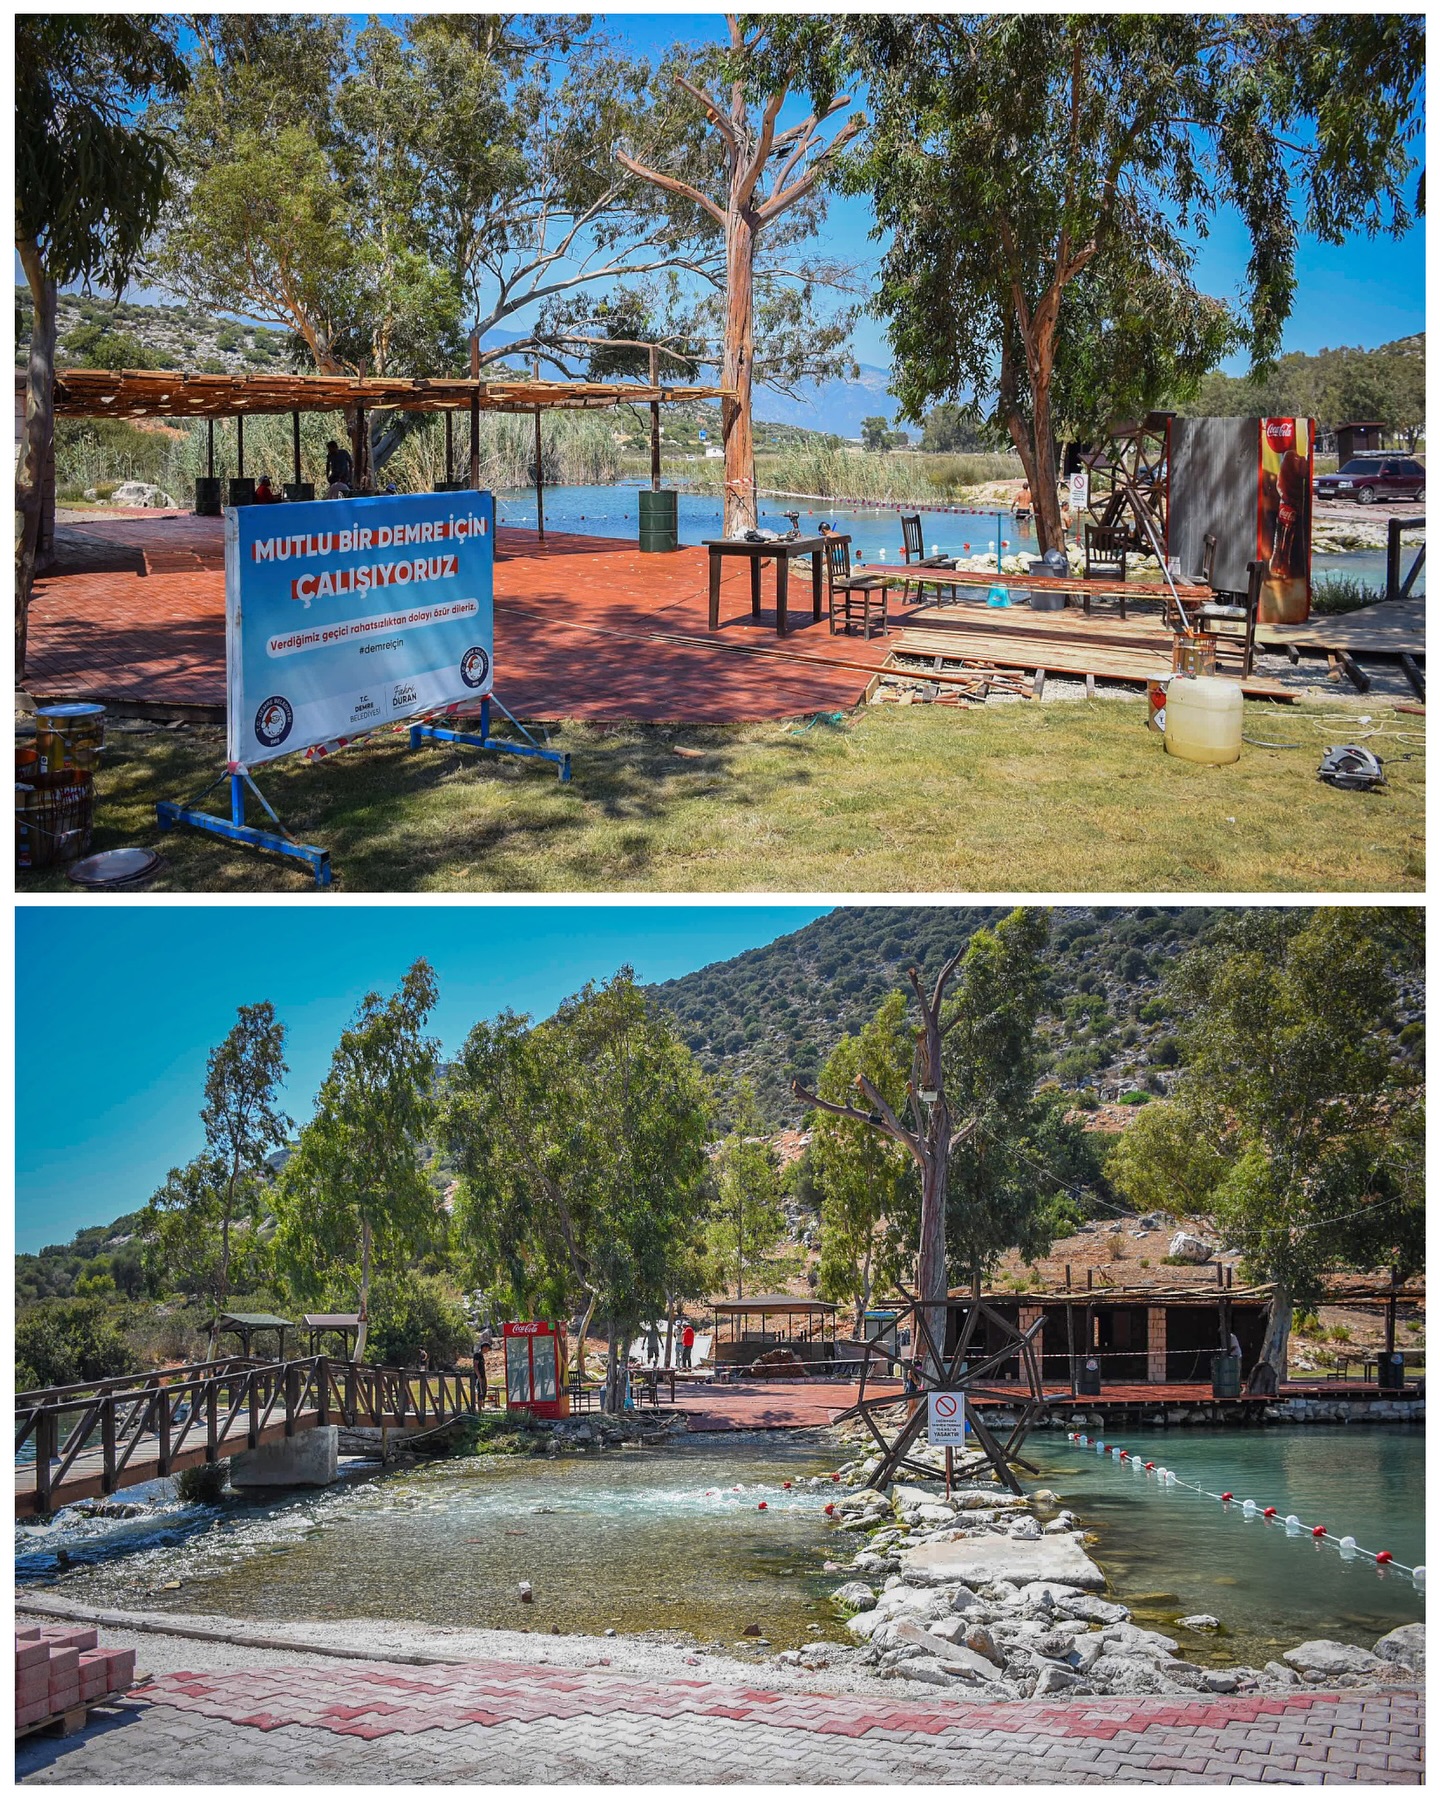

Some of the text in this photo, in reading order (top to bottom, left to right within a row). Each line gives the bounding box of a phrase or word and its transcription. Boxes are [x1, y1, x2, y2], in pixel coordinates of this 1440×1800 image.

[255, 511, 486, 564] MUTLU BİR DEMRE İÇİN
[296, 553, 455, 609] ÇALIŞIYORUZ
[270, 602, 476, 651] Verdiğimiz geçici rahatsızlıktan dolayı özür dileriz.
[359, 638, 404, 654] #demreiçin
[355, 702, 374, 712] DEMRE
[360, 695, 370, 703] T.C.
[392, 692, 417, 706] DURAN
[350, 706, 381, 723] BELEDİYESİ
